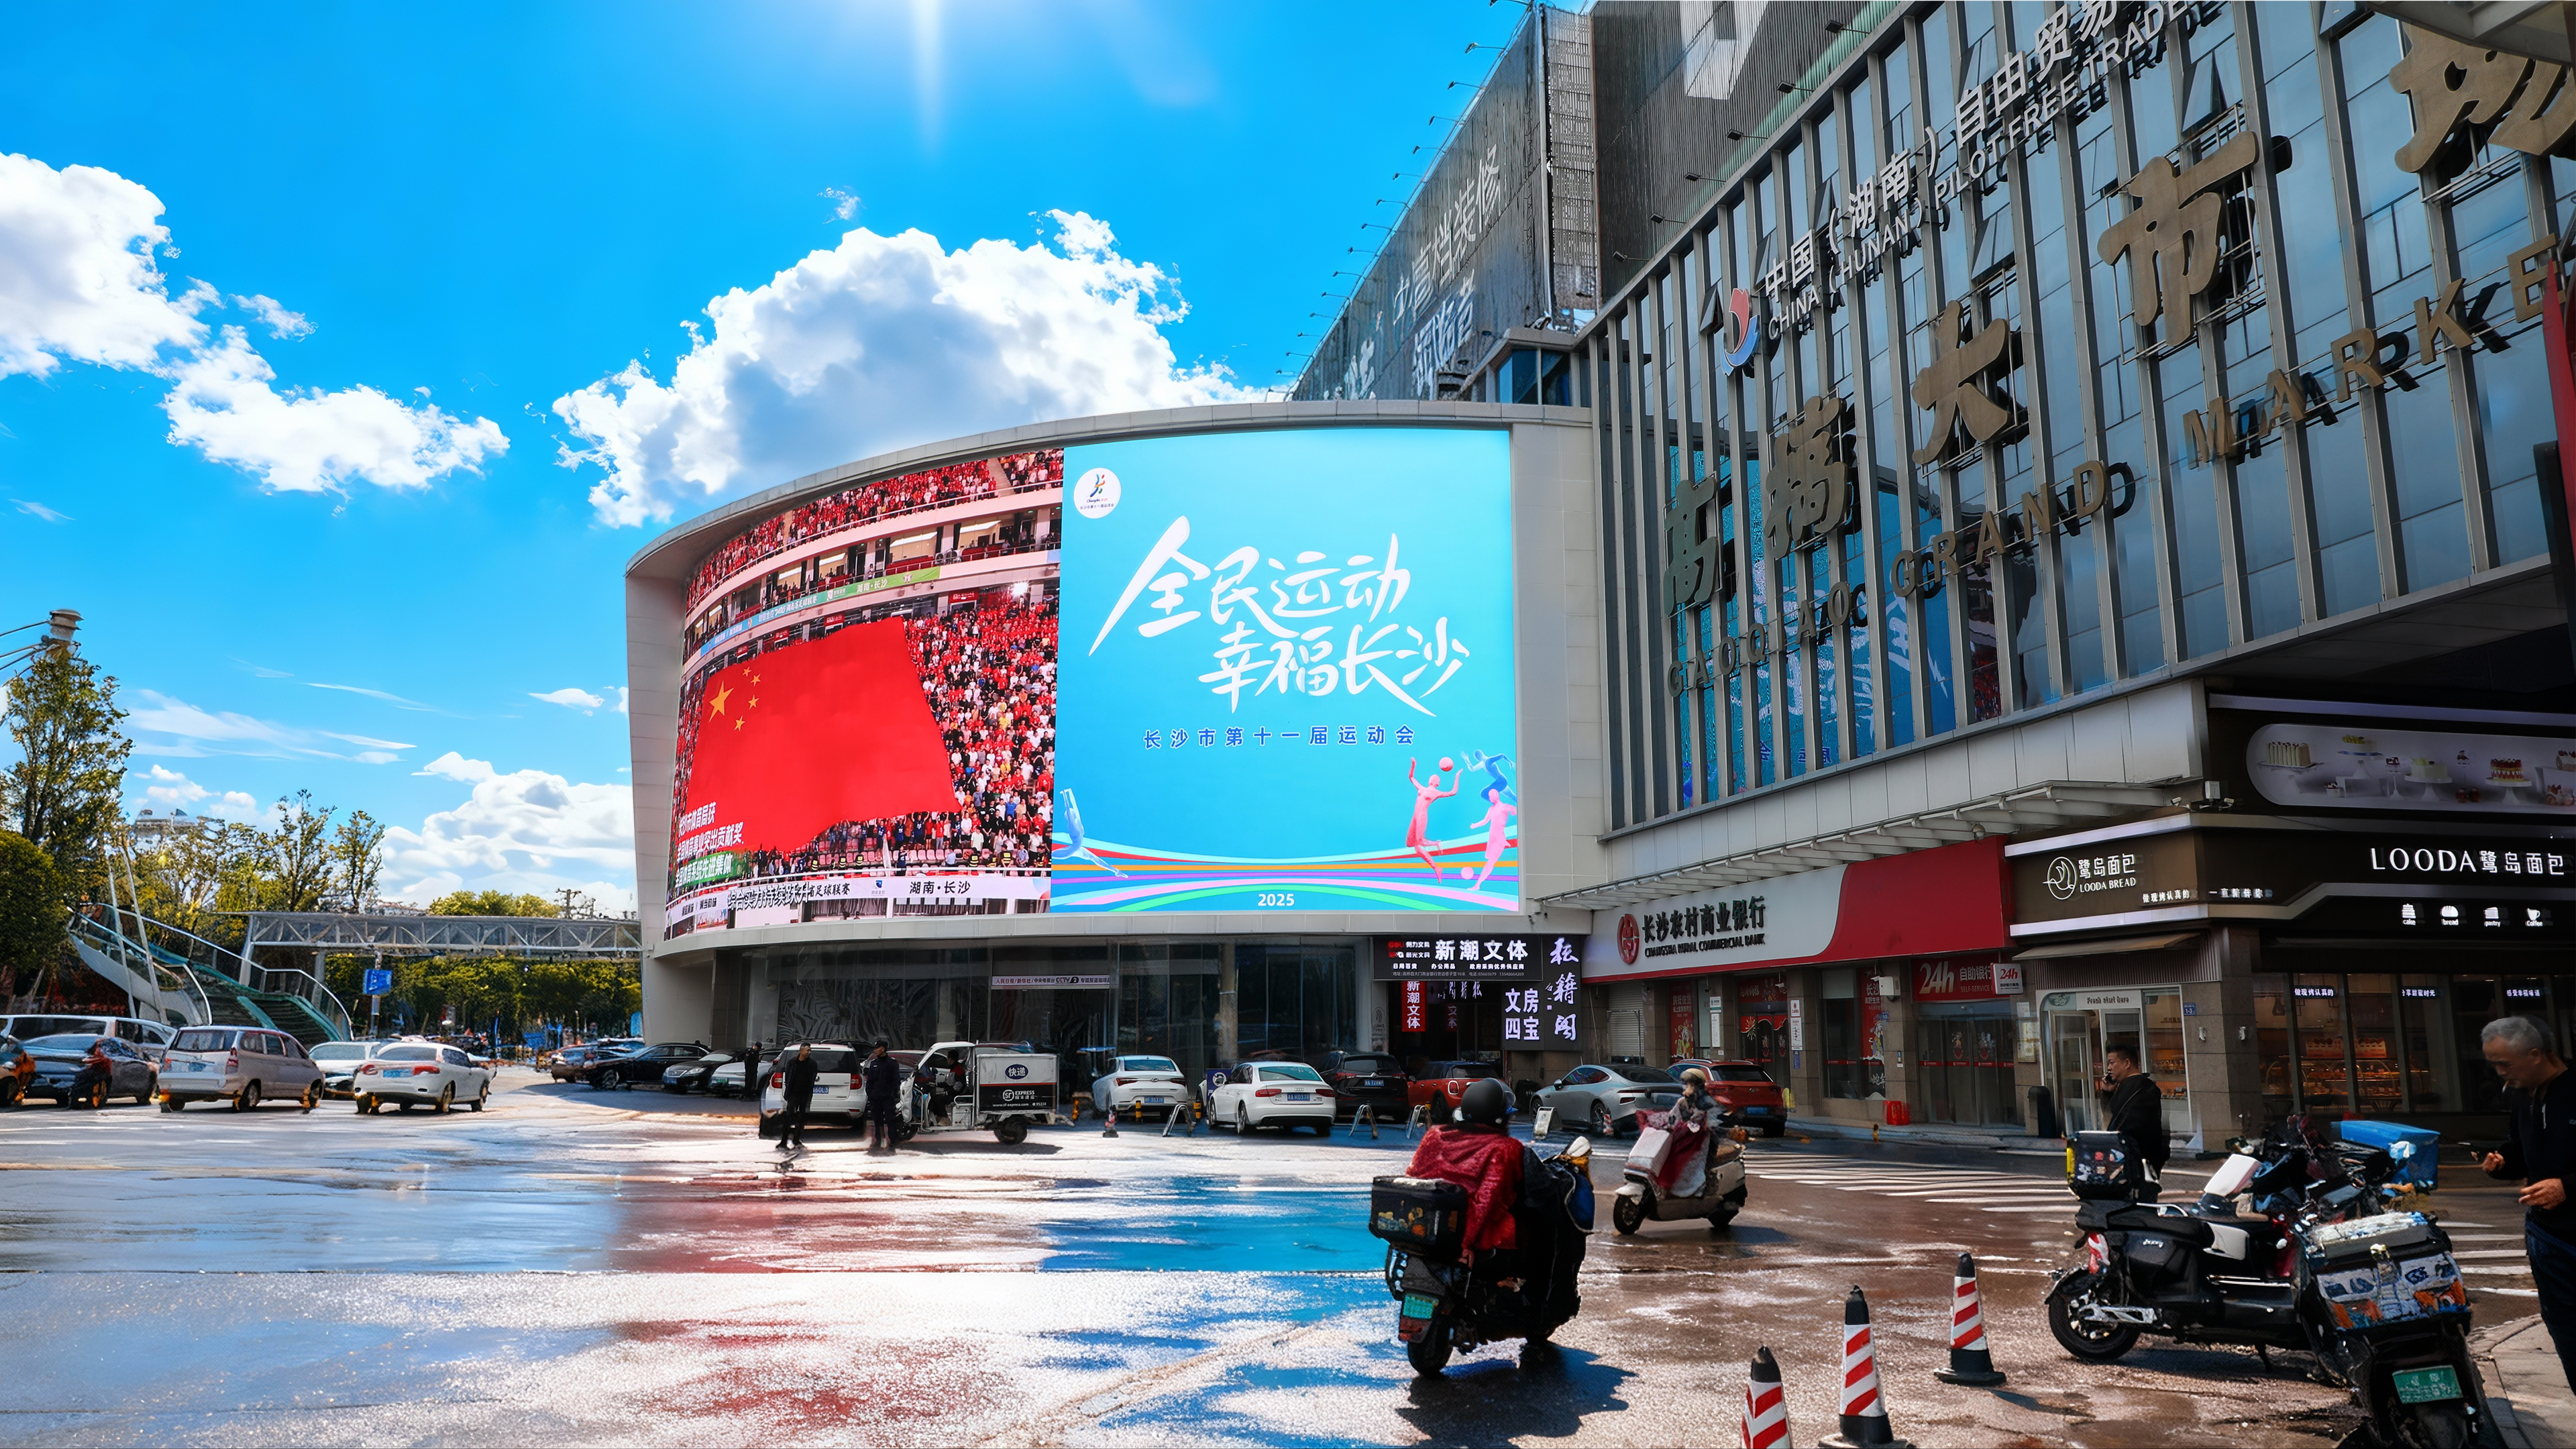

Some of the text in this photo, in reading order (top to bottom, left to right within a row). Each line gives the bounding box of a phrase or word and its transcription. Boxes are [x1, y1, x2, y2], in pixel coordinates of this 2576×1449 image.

[1768, 291, 1820, 341] CHINA
[1935, 138, 2002, 211] PILOT
[2008, 70, 2080, 149] FREE
[1088, 515, 1411, 657] 全民运动
[1667, 581, 1852, 698] GAOQIAO
[1890, 460, 2107, 598] GRAND
[1198, 616, 1470, 717] 幸福长沙
[1143, 724, 1415, 750] 长沙市第十一届运动会
[679, 802, 716, 838] 长沙市体育局获
[675, 853, 733, 888] 全国体育系统先进集体
[2078, 853, 2136, 879] 鹭岛面包
[2370, 847, 2565, 875] LOODA 鹭岛面包
[728, 881, 810, 911] 综合实力持续跃升
[910, 881, 971, 894] 湖南·长沙
[2080, 877, 2137, 893] LOODA BREAD
[1258, 894, 1295, 906] 2025
[1642, 896, 1766, 943] 长沙农村商业银行
[1435, 939, 1528, 961] 新潮文体
[1645, 932, 1766, 958] CHANGSHA RURAL COMMERCIAL BANK
[1919, 961, 1955, 994] 24h
[2000, 967, 2019, 979] 24h
[1505, 988, 1540, 1014] 文房
[1960, 985, 1990, 993] SELF-SERVICE
[2116, 996, 2129, 1004] here
[2294, 988, 2334, 997] 做现烤认真的
[1407, 981, 1421, 1029] 新潮文体
[1505, 1016, 1540, 1040] 四宝
[1008, 1067, 1026, 1077] 快递
